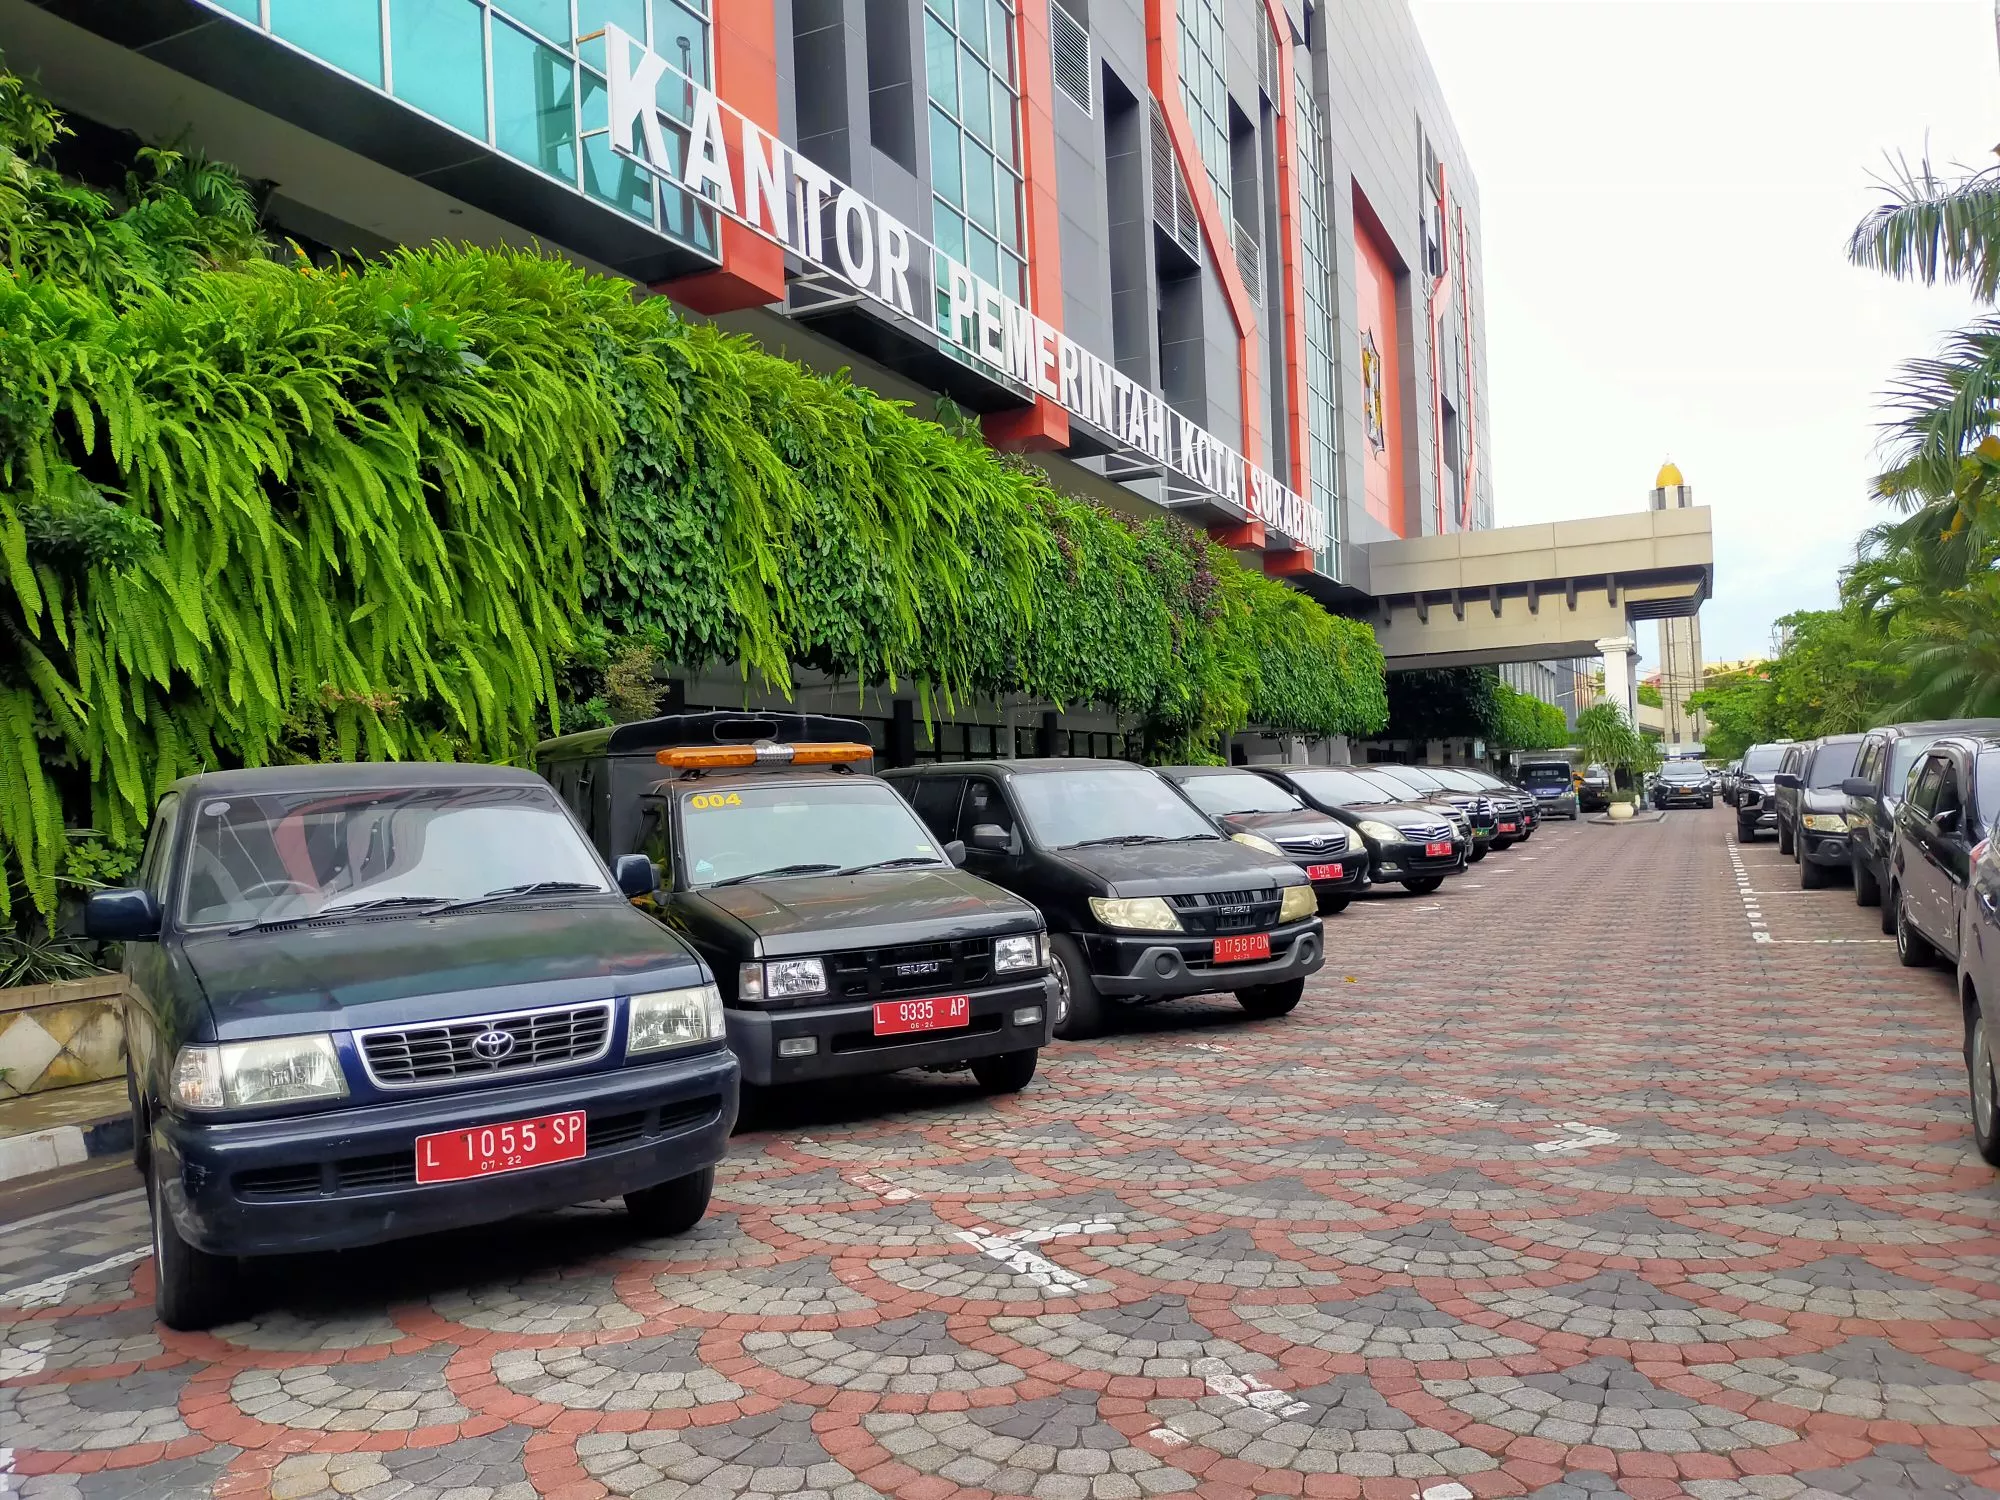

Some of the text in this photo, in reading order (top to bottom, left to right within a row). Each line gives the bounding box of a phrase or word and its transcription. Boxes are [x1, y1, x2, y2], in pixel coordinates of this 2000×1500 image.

[605, 22, 1325, 555] KANTOR PEMERINTAH KOTA SURABAYA
[692, 792, 743, 809] 004
[1221, 905, 1251, 915] ISUZU
[1214, 940, 1221, 955] B
[1225, 938, 1248, 953] 1758
[896, 962, 939, 976] ISUZU
[876, 998, 966, 1024] L 9335 AP
[427, 1115, 581, 1167] L 1055 SP
